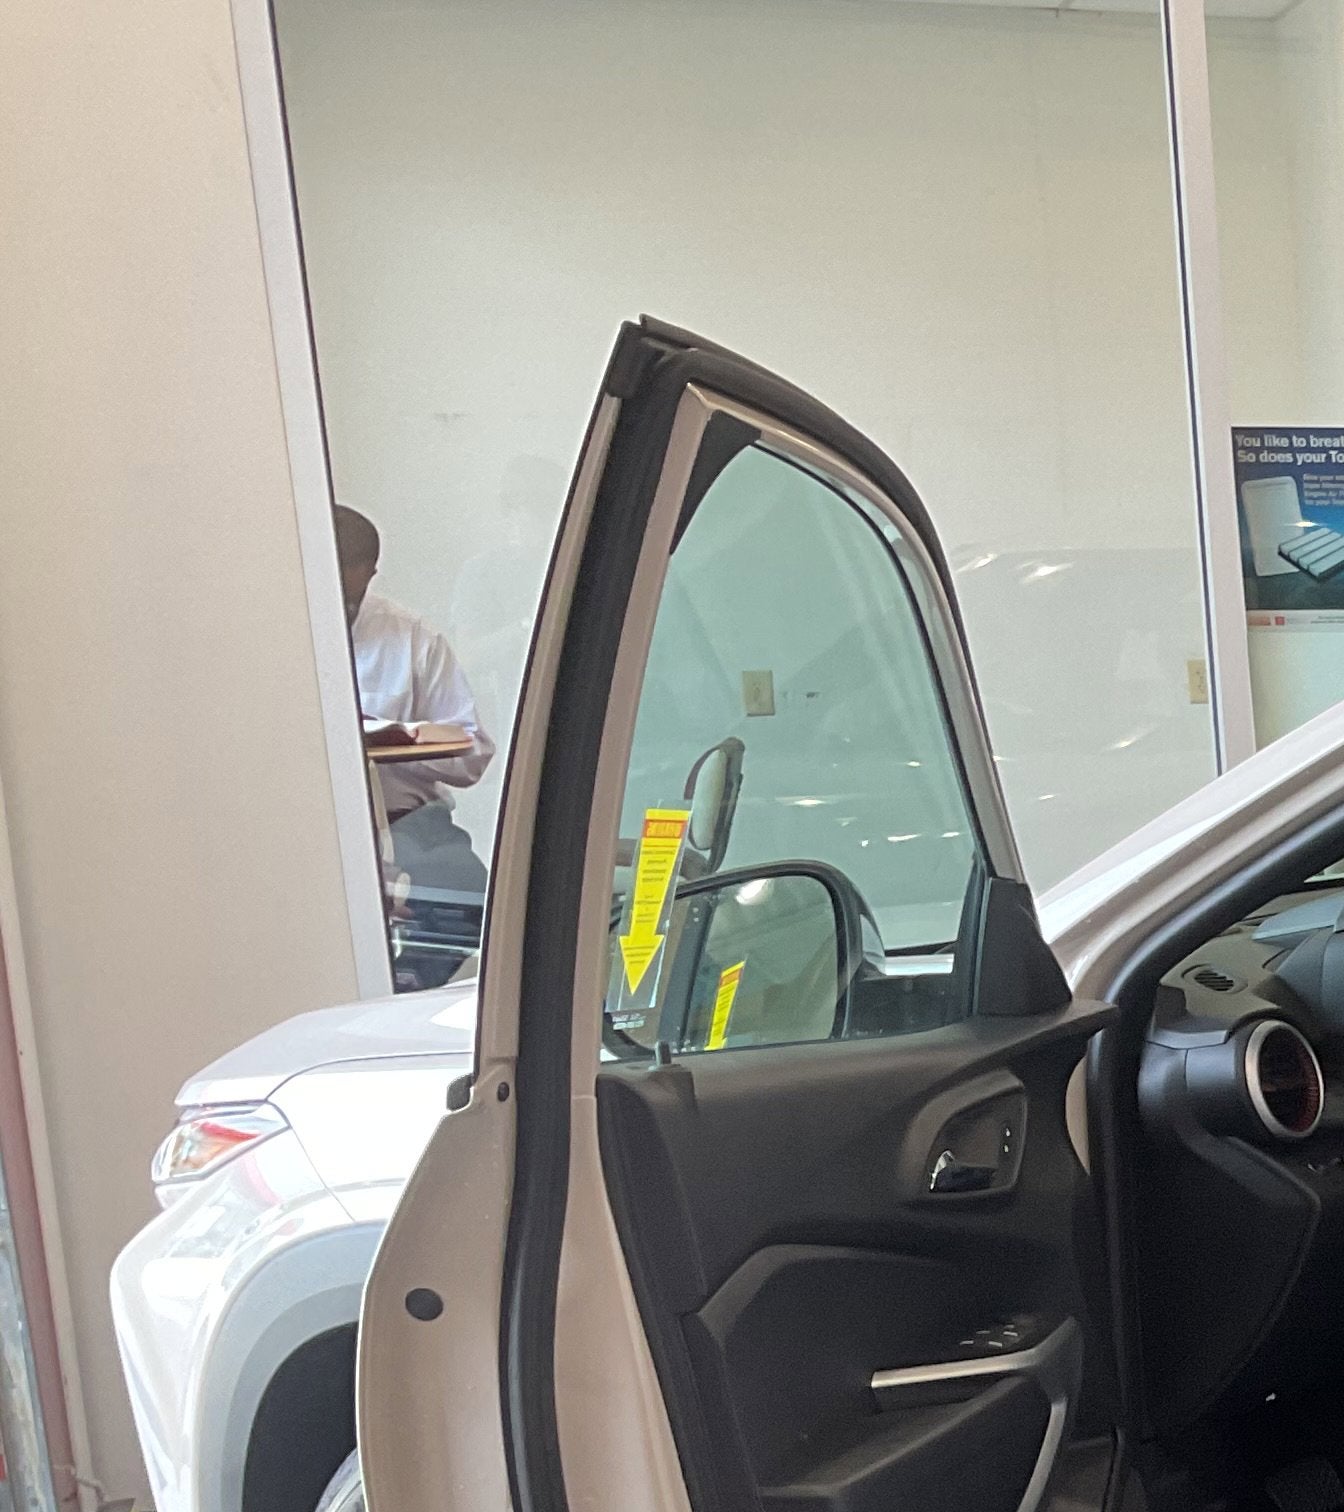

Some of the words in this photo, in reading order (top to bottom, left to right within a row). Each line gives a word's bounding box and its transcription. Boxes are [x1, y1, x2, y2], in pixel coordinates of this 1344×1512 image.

[1236, 434, 1261, 447] You
[1264, 434, 1289, 447] like
[1292, 434, 1307, 447] to
[1237, 449, 1256, 463] So
[1260, 449, 1294, 463] does
[1296, 452, 1327, 466] your
